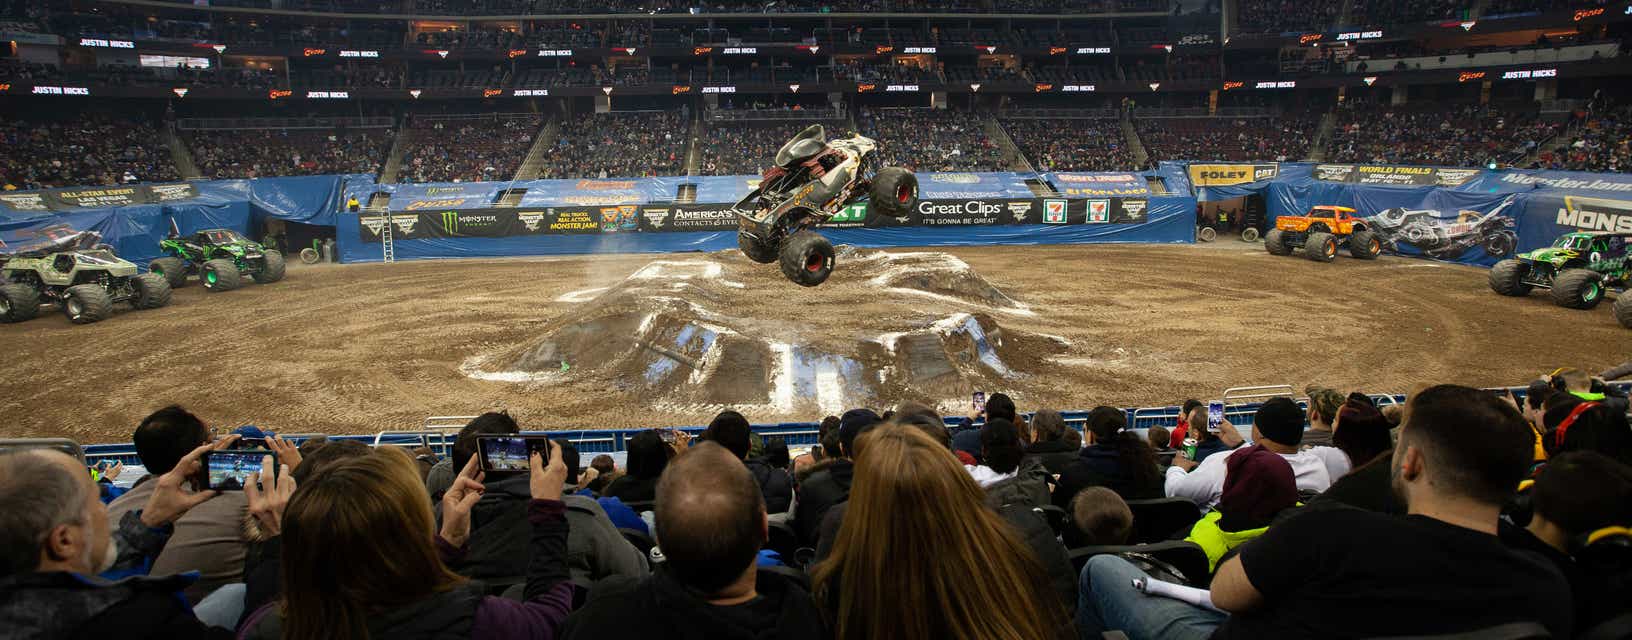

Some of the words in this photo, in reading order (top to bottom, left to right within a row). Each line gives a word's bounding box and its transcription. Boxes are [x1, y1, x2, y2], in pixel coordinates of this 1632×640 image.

[1337, 32, 1361, 40] JUSTIN
[1362, 31, 1382, 39] HICKS
[80, 39, 109, 47] JUSTIN
[110, 40, 134, 48] HICKS
[1502, 70, 1531, 79] JUSTIN
[1532, 69, 1556, 78] HICKS
[1256, 80, 1277, 88] JUSTIN
[1278, 80, 1295, 88] HICKS
[32, 86, 62, 94] JUSTIN
[63, 87, 88, 95] HICKS
[1200, 171, 1247, 179] FOLEY
[1256, 169, 1274, 178] CAT
[834, 206, 866, 218] KT
[918, 201, 963, 214] Great
[966, 200, 1000, 215] Clips
[674, 209, 733, 219] AMERICA'S
